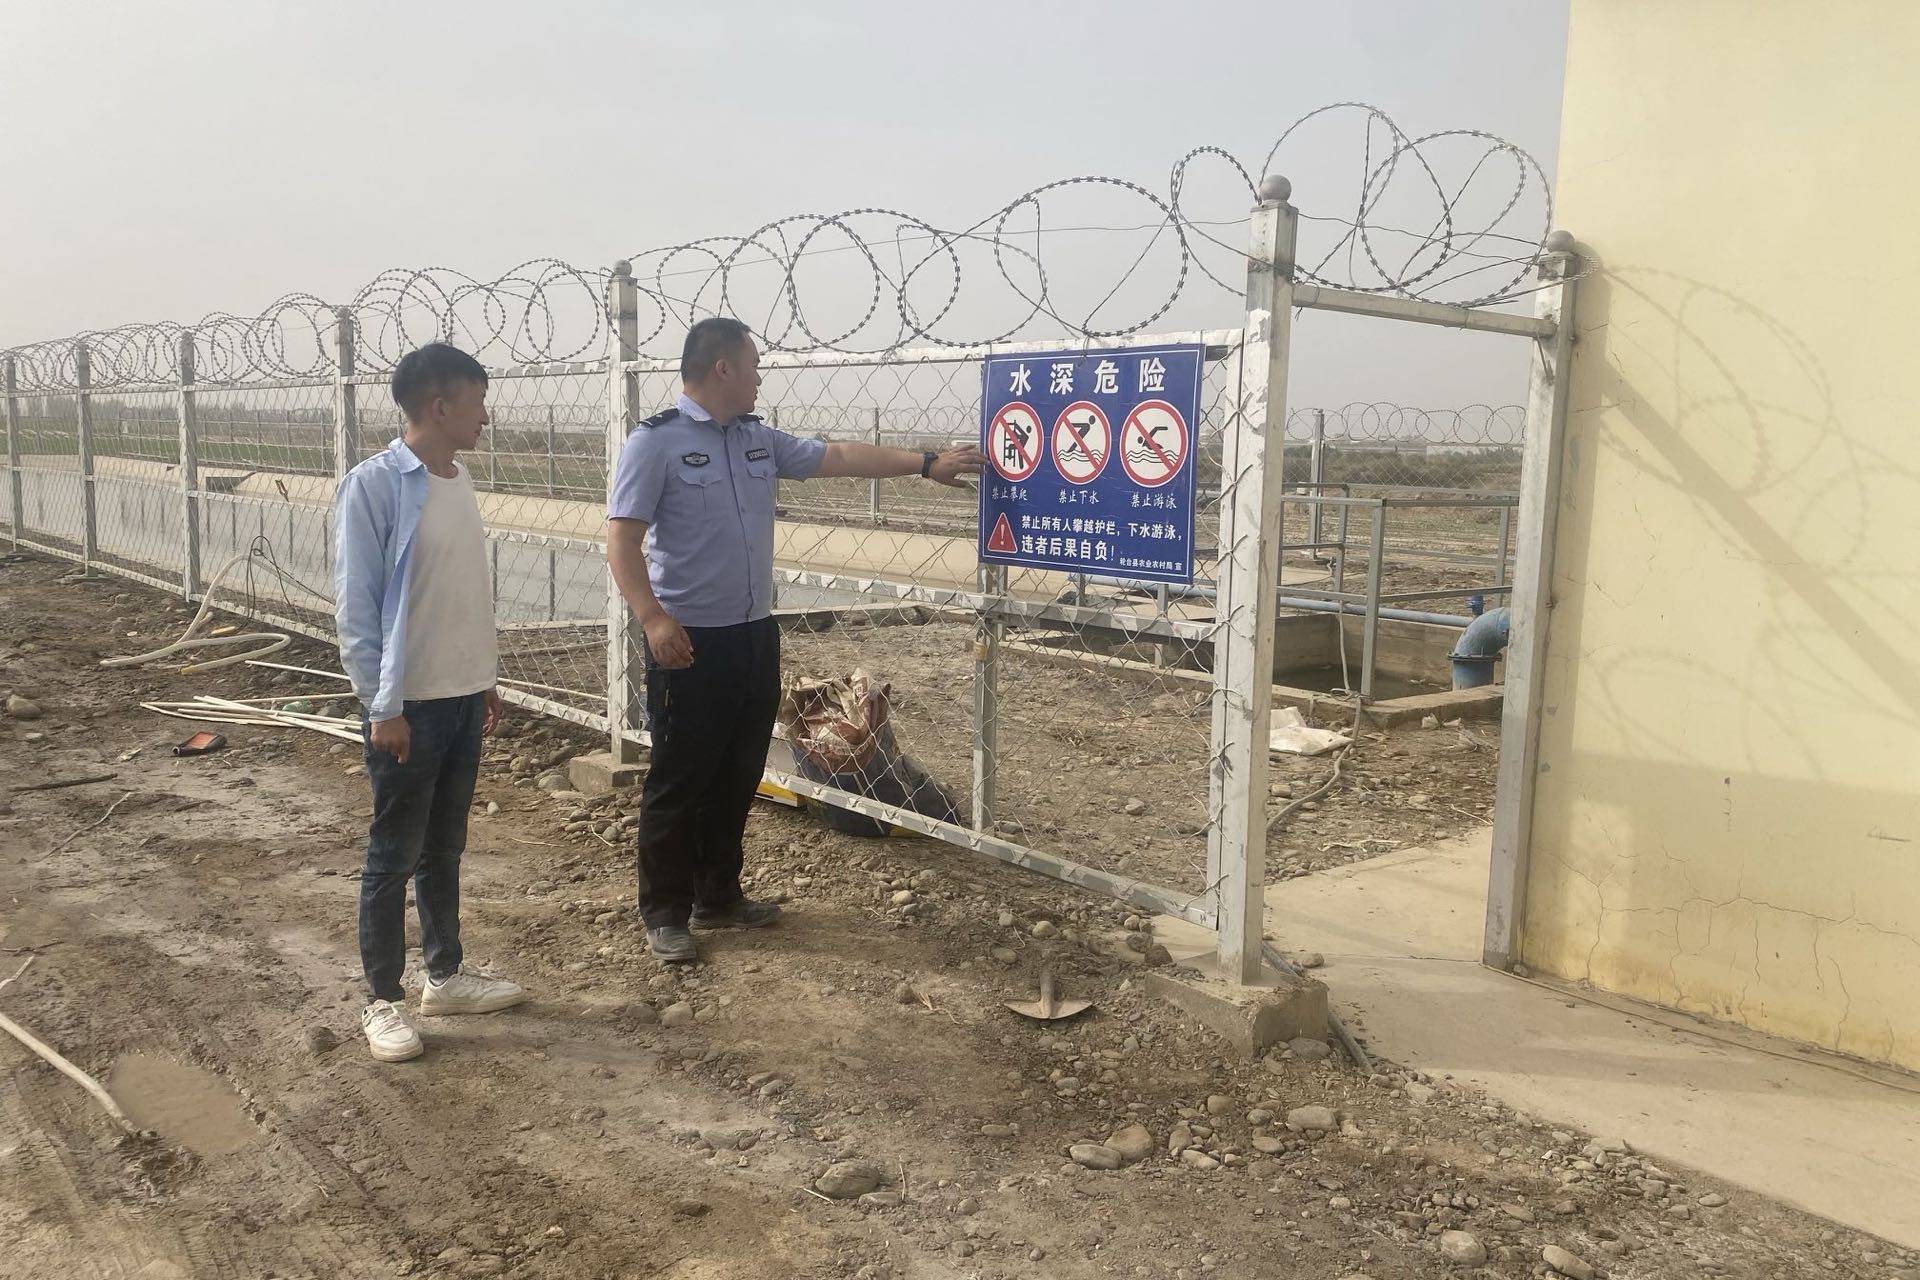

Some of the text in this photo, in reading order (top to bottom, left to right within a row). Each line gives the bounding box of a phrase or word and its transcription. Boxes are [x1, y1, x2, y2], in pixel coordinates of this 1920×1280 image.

[1009, 357, 1166, 396] 水深危险
[1058, 488, 1099, 504] 禁止下水
[1130, 493, 1177, 509] 禁止游泳
[1021, 535, 1115, 561] 违者后果自负！
